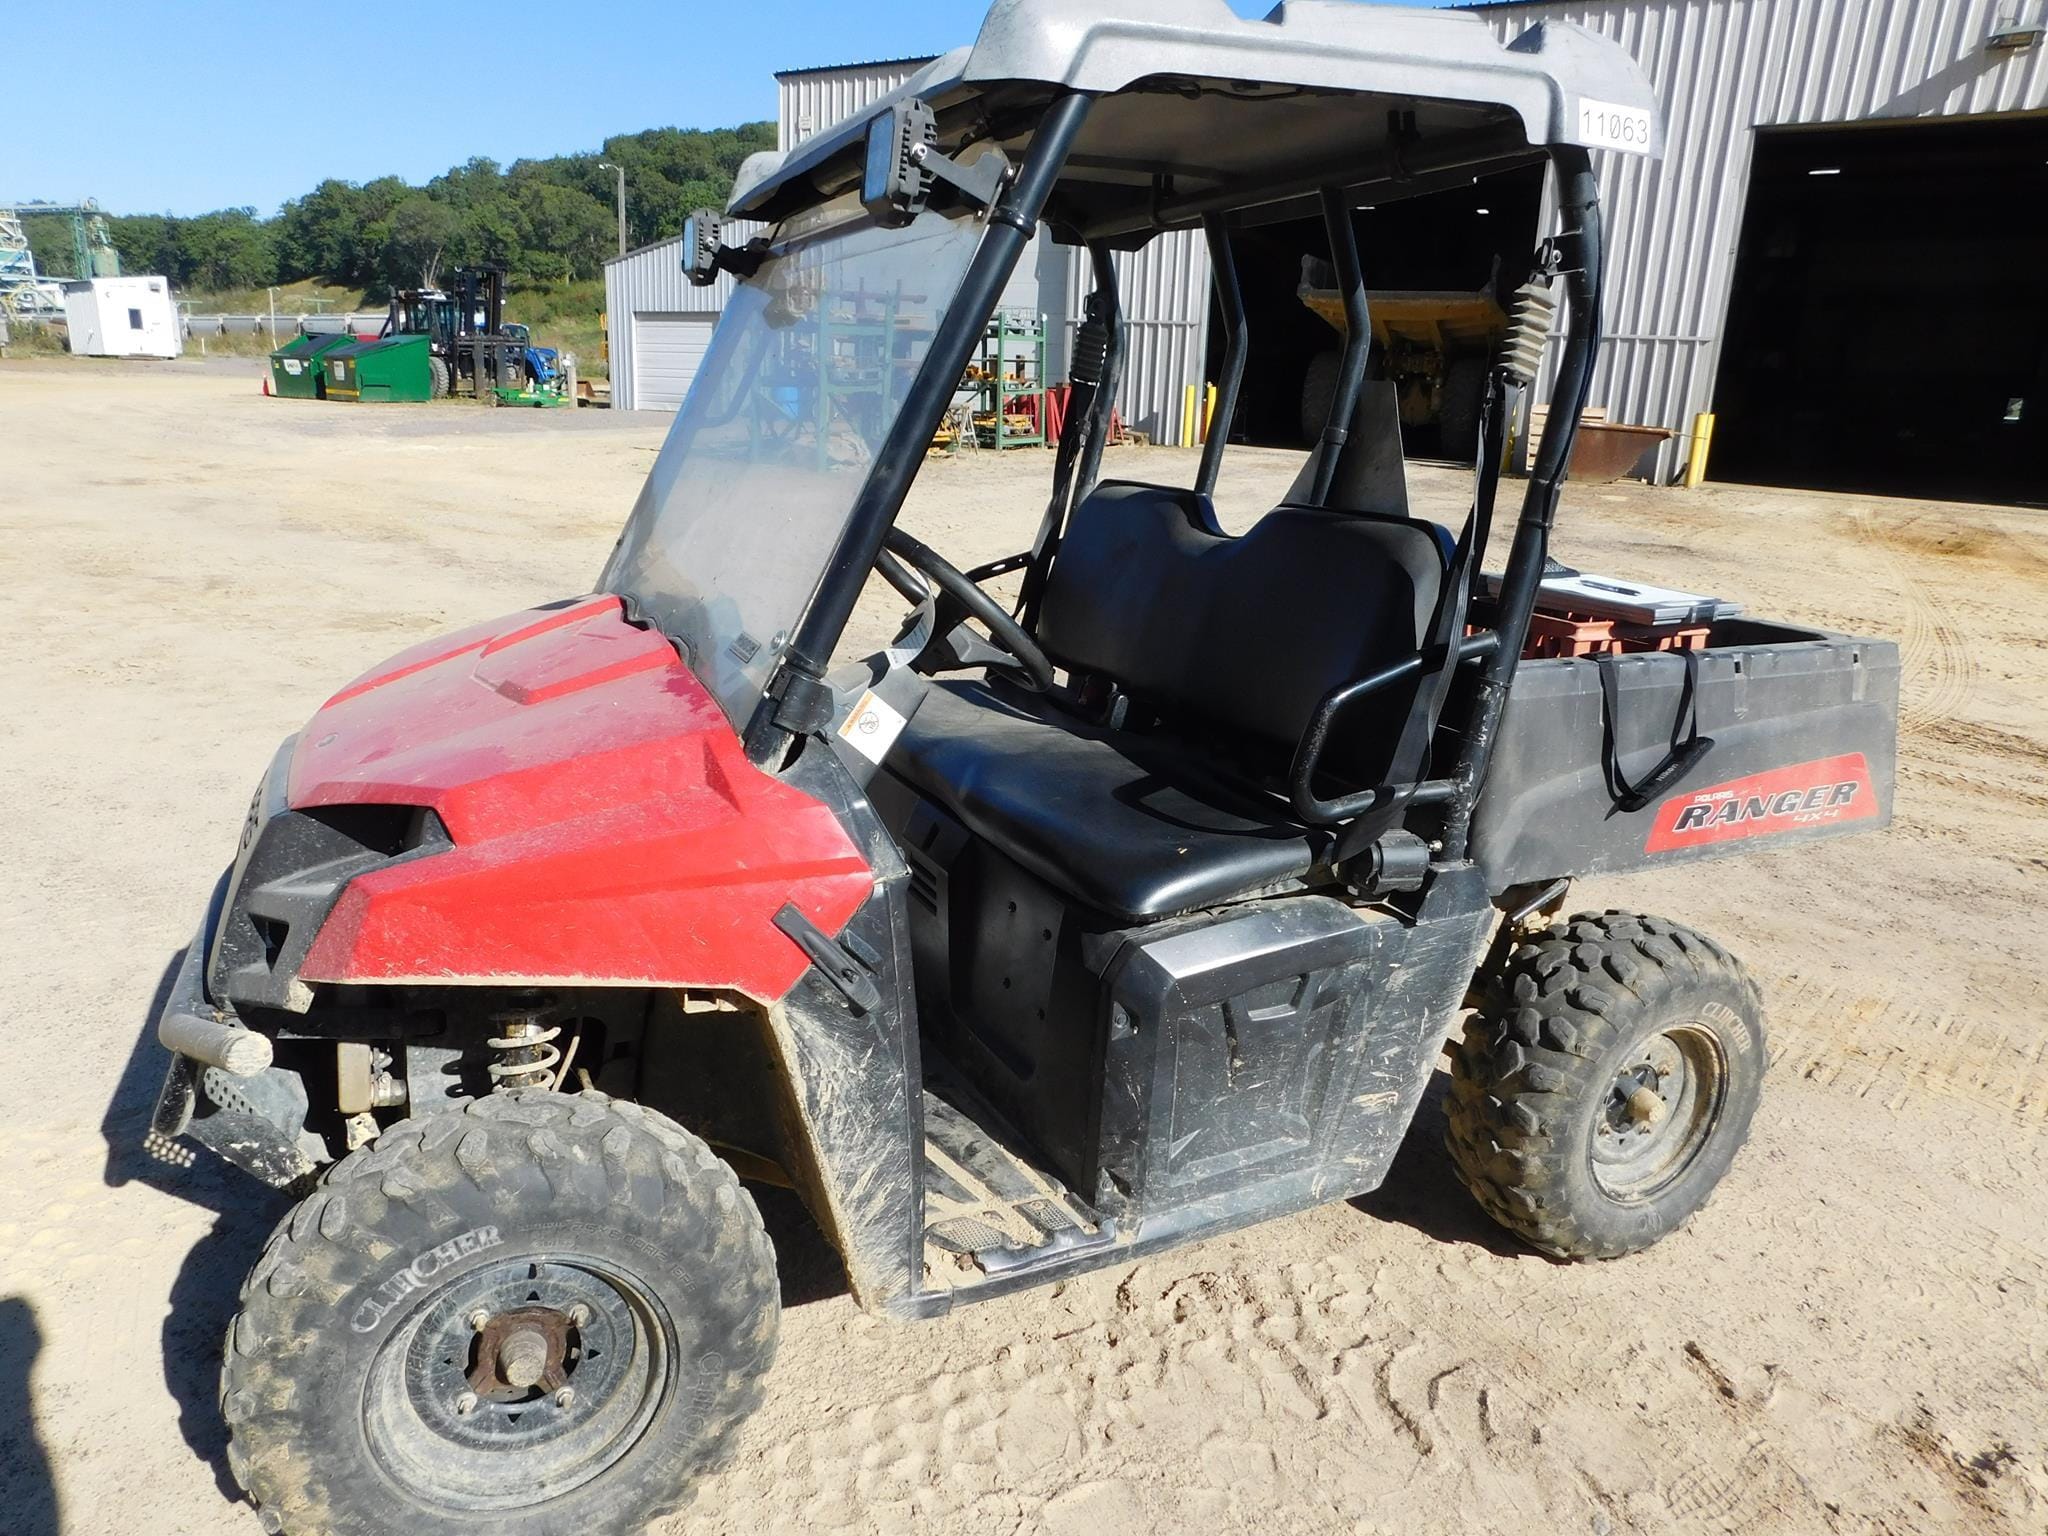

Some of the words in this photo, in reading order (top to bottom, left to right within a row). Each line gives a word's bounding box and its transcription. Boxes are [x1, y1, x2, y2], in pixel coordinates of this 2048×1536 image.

[1583, 109, 1647, 144] 11063
[1673, 781, 1858, 832] RANGER
[1693, 790, 1734, 804] POLARIS
